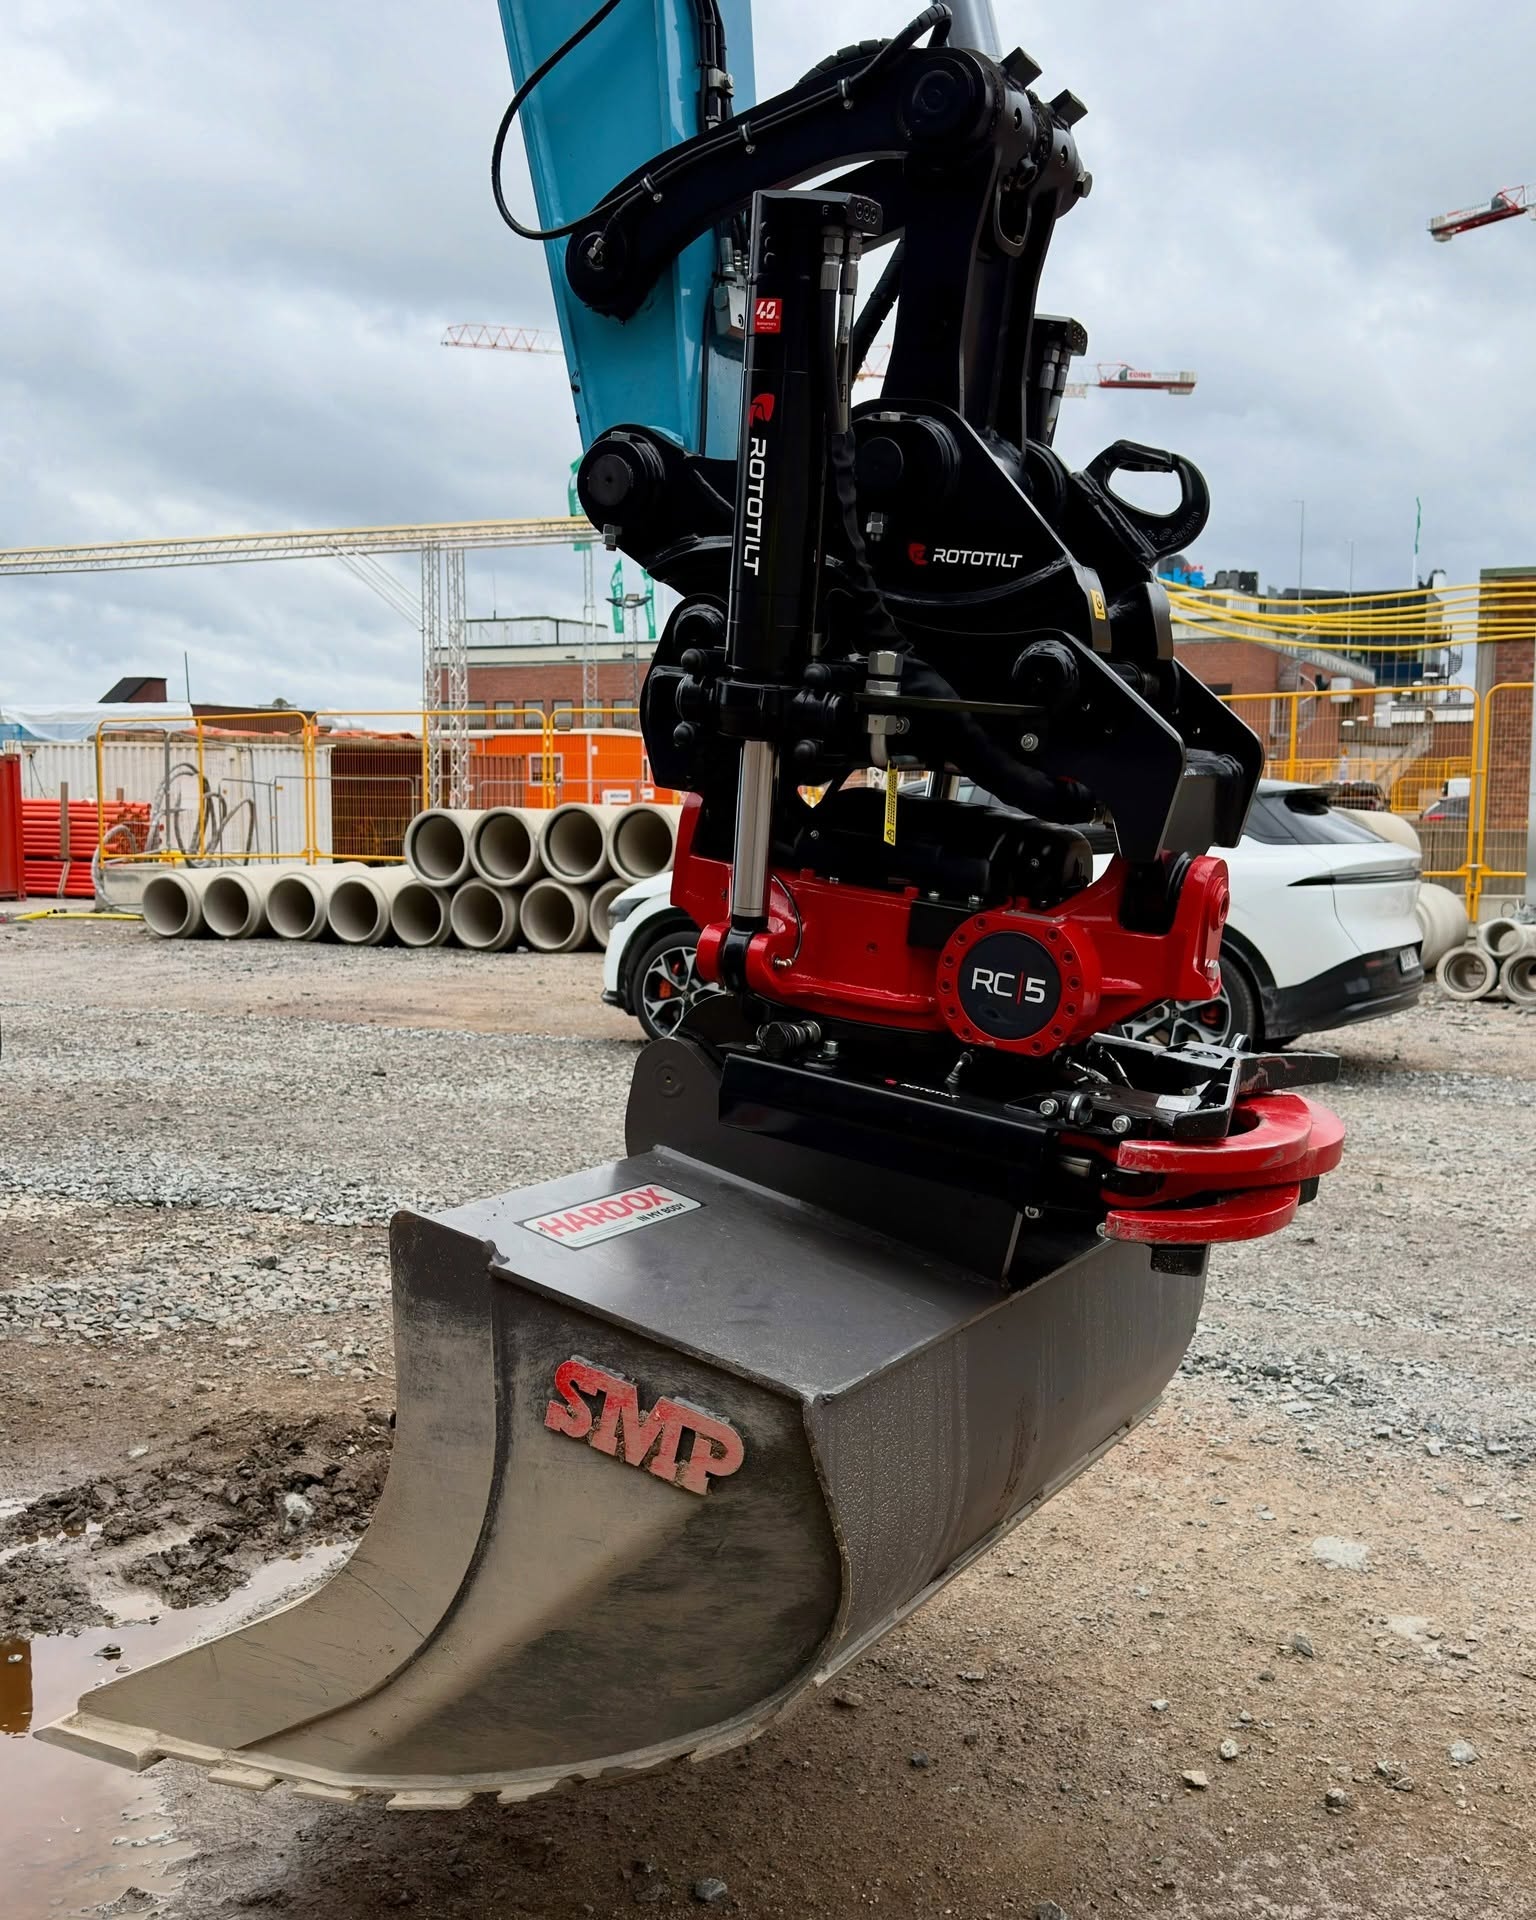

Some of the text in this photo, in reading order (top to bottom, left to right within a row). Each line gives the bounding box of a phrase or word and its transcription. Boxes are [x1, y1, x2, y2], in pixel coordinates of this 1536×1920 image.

[743, 437, 767, 576] ROTOTILT
[932, 548, 1023, 569] ROTOTILT
[537, 1186, 673, 1237] HARDOX
[636, 1203, 686, 1222] IN MY BODY
[544, 1356, 745, 1496] SMP
